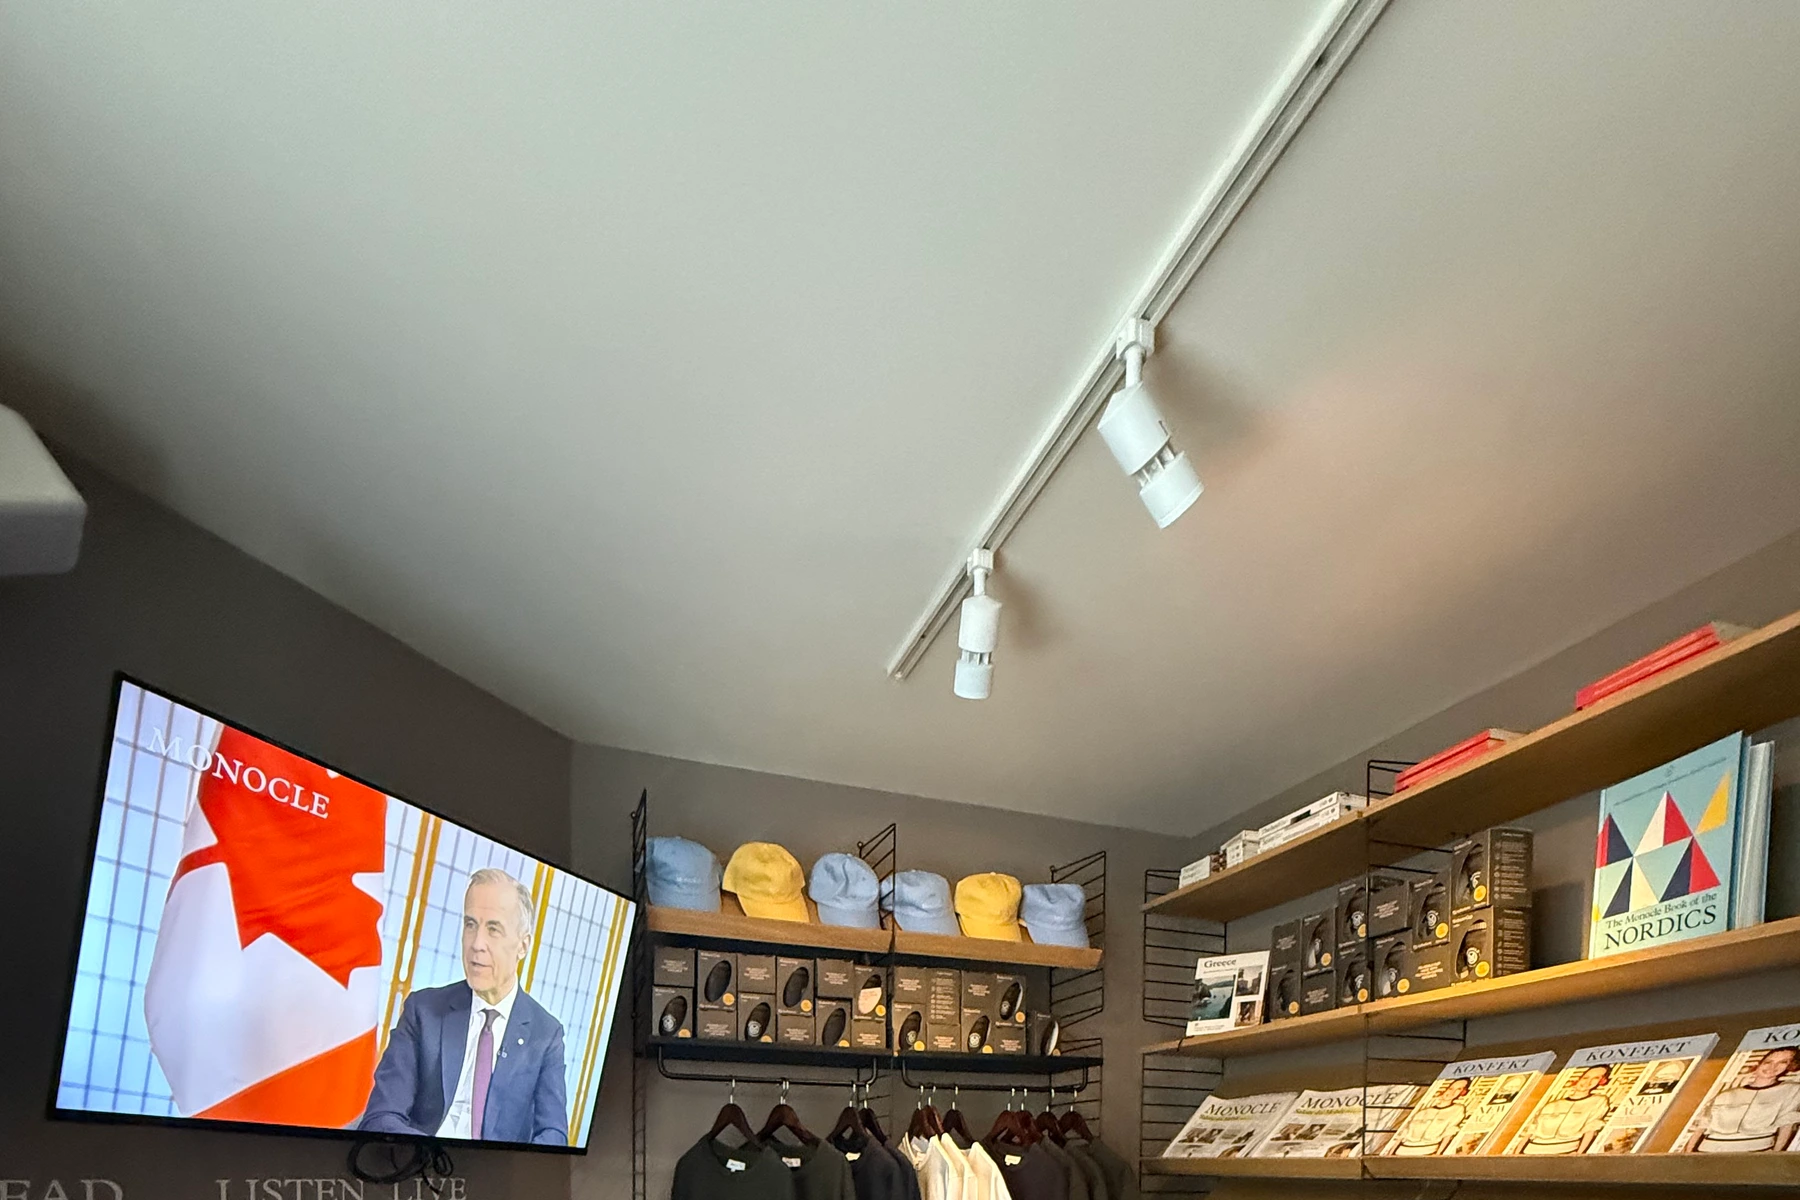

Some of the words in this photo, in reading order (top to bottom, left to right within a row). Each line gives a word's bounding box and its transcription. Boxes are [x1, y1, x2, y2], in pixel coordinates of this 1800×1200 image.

[147, 727, 330, 819] MONOCLE
[1606, 918, 1623, 929] The
[1625, 908, 1661, 923] Monocle
[1664, 901, 1687, 913] Book
[1690, 897, 1699, 906] of
[1702, 893, 1717, 903] the
[1604, 904, 1717, 950] NORDICS
[1203, 959, 1237, 969] Greece
[1585, 1040, 1692, 1062] KONFEKT
[1452, 1058, 1531, 1075] KONFEKT
[1204, 1102, 1281, 1116] MONOCLE
